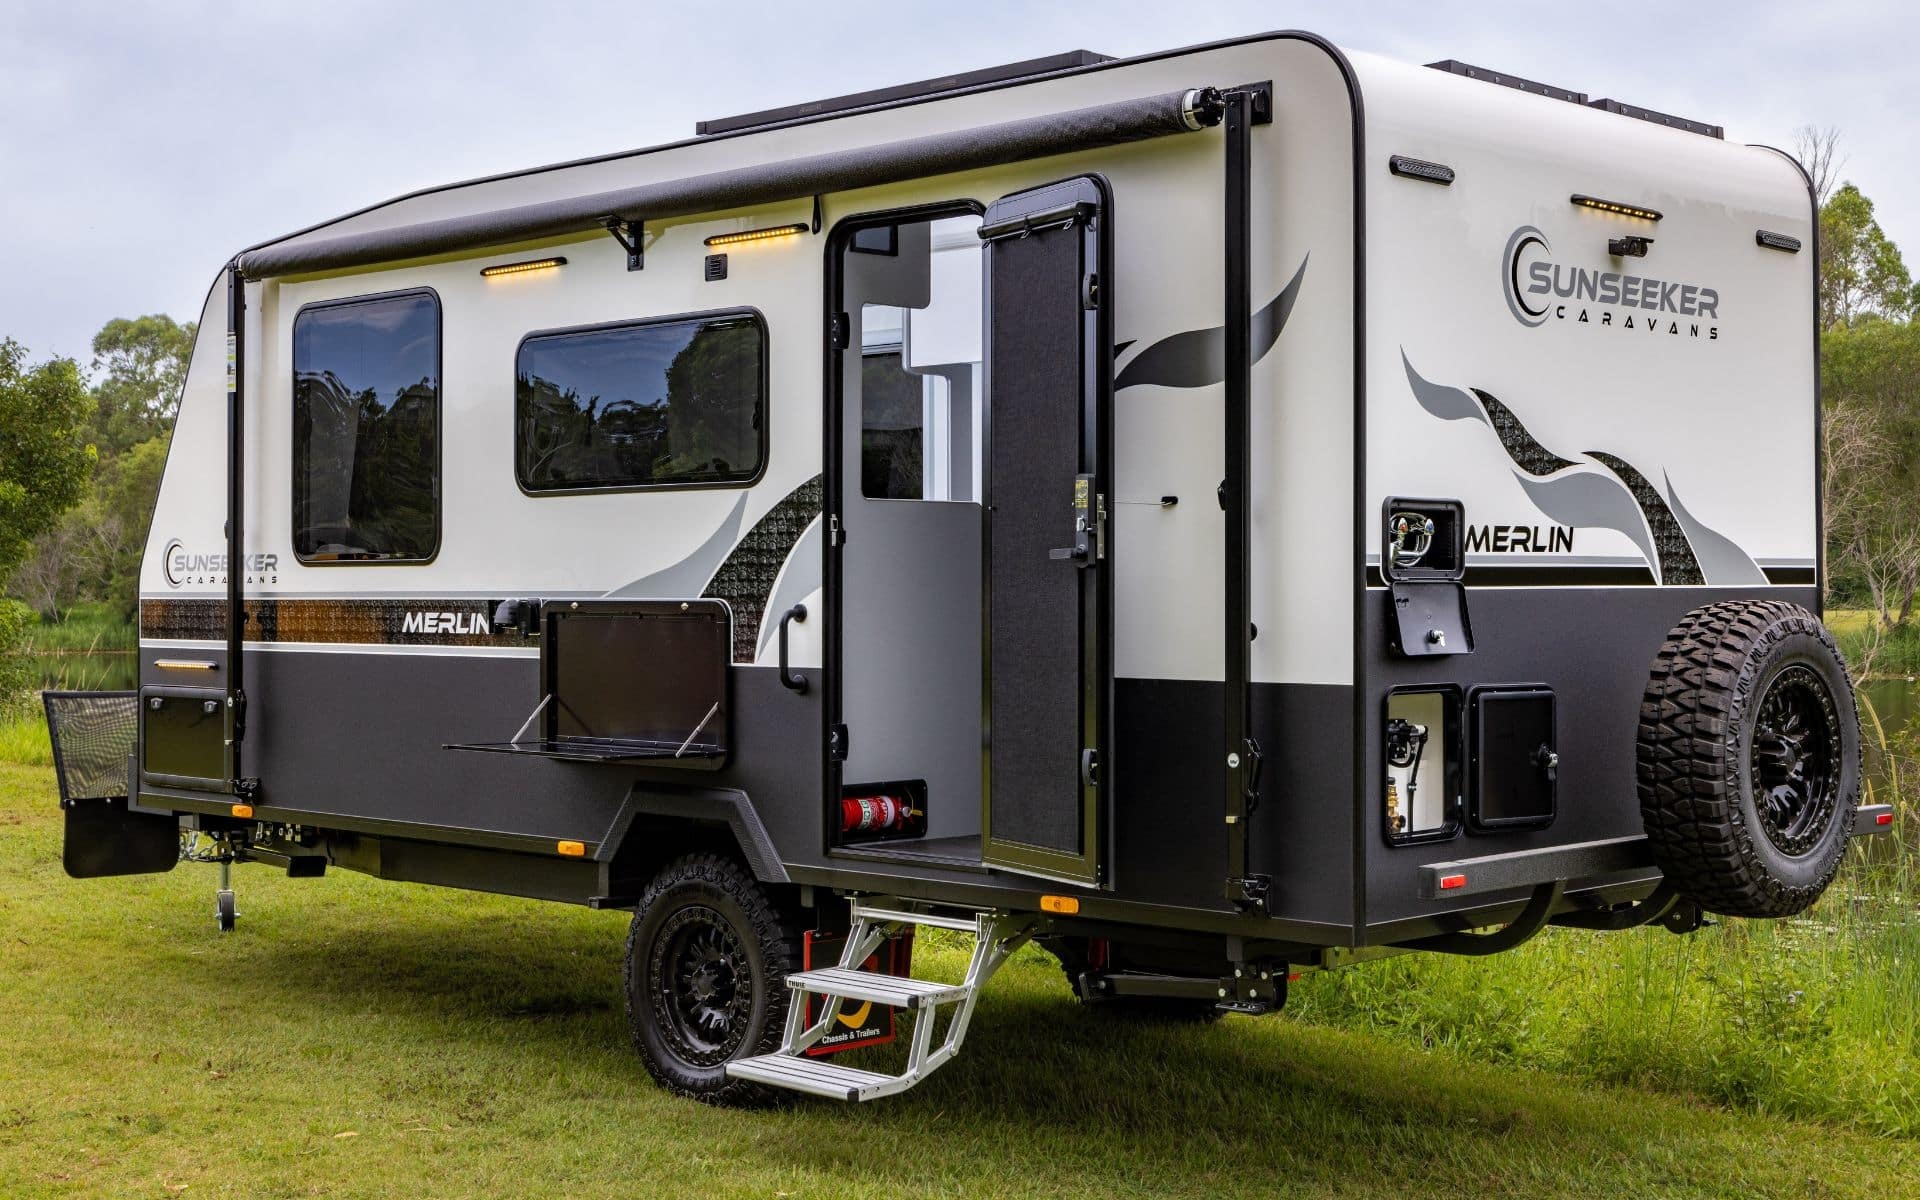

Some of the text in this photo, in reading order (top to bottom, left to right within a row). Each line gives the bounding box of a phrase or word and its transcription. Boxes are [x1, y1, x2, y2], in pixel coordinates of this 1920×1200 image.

[1527, 261, 1719, 319] SUNSEEKER
[1556, 305, 1719, 340] CARAVANS
[1464, 524, 1574, 553] MERLIN
[174, 553, 279, 572] SUNSEKER
[186, 576, 278, 584] CARAANS
[401, 611, 490, 635] MERLIN
[788, 980, 806, 989] THULE
[822, 1028, 880, 1044] Chassis & Trailers
